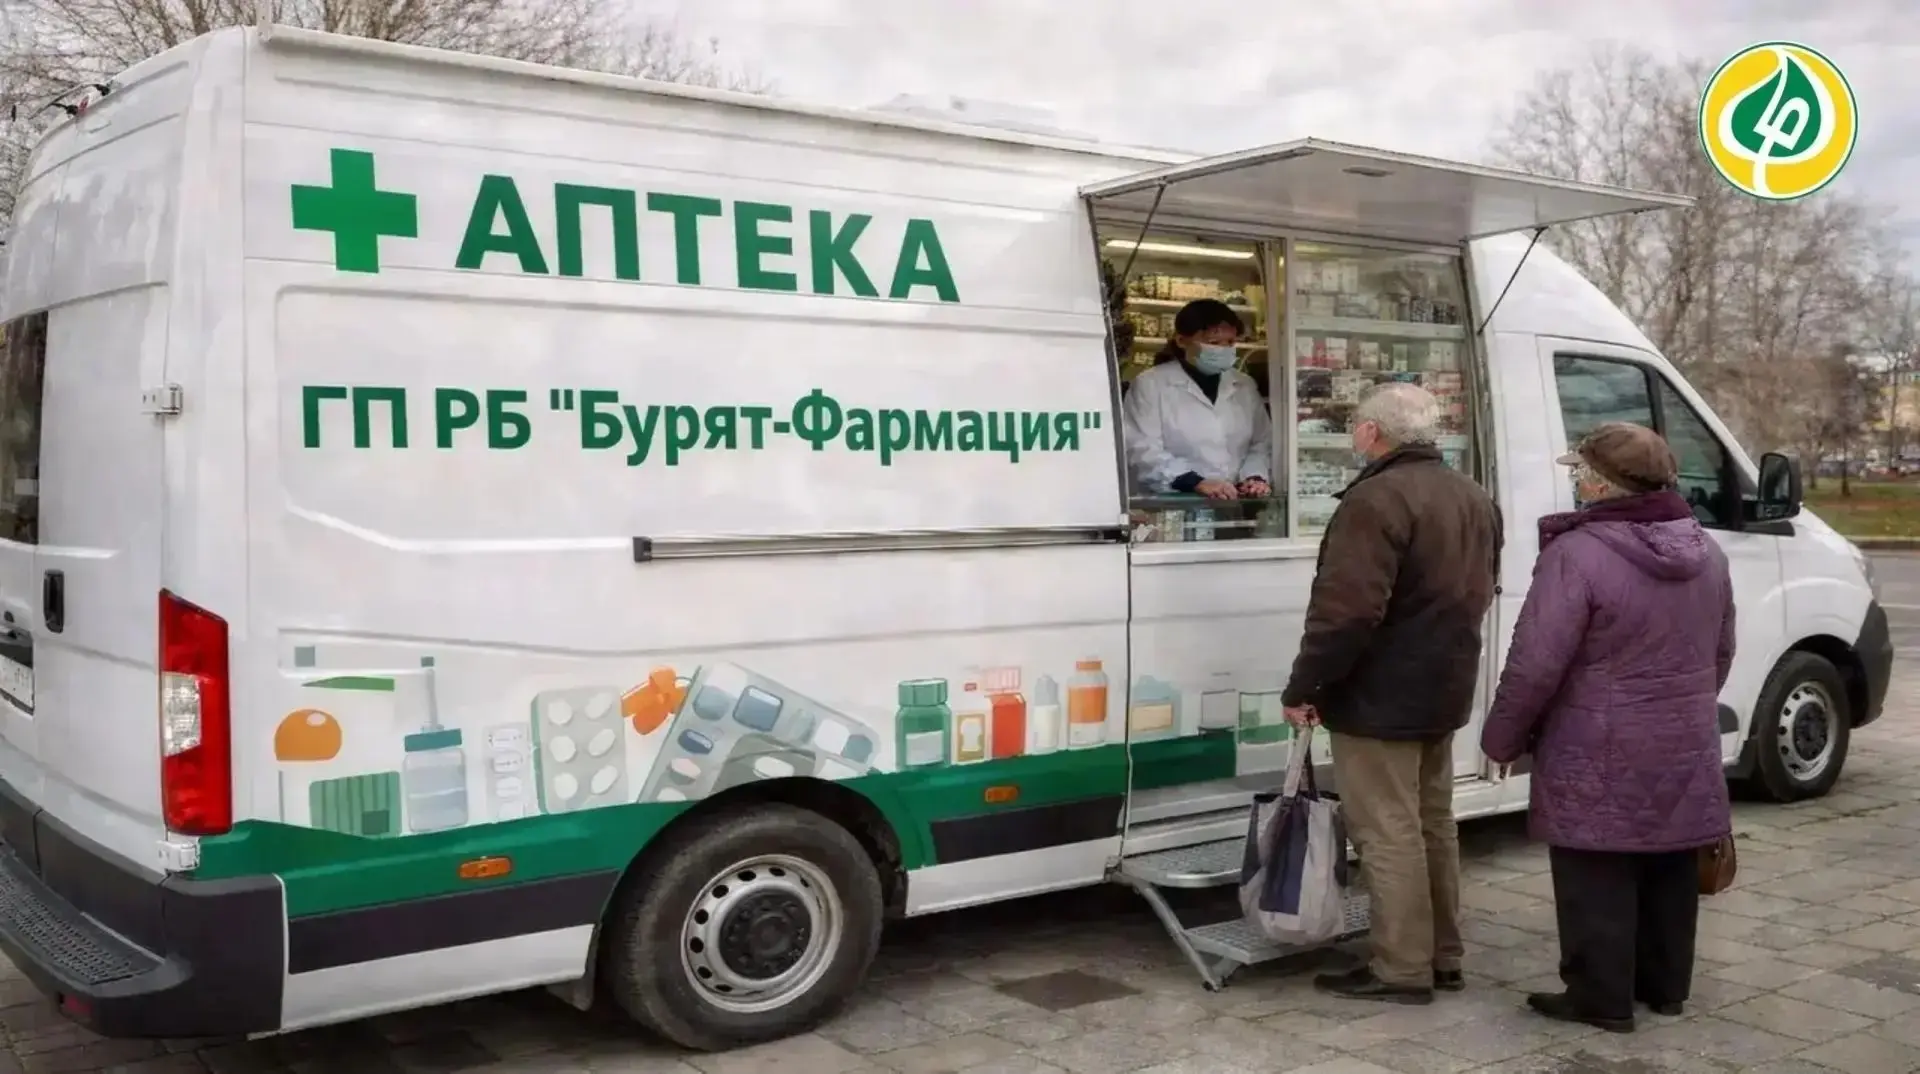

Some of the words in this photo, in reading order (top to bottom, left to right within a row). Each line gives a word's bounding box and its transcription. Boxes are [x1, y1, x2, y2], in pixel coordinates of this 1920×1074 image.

[456, 174, 959, 303] АПТЕКА
[302, 385, 409, 449] ГП
[435, 387, 532, 450] РБ
[549, 387, 1102, 467] "Бурят-Фармация"
